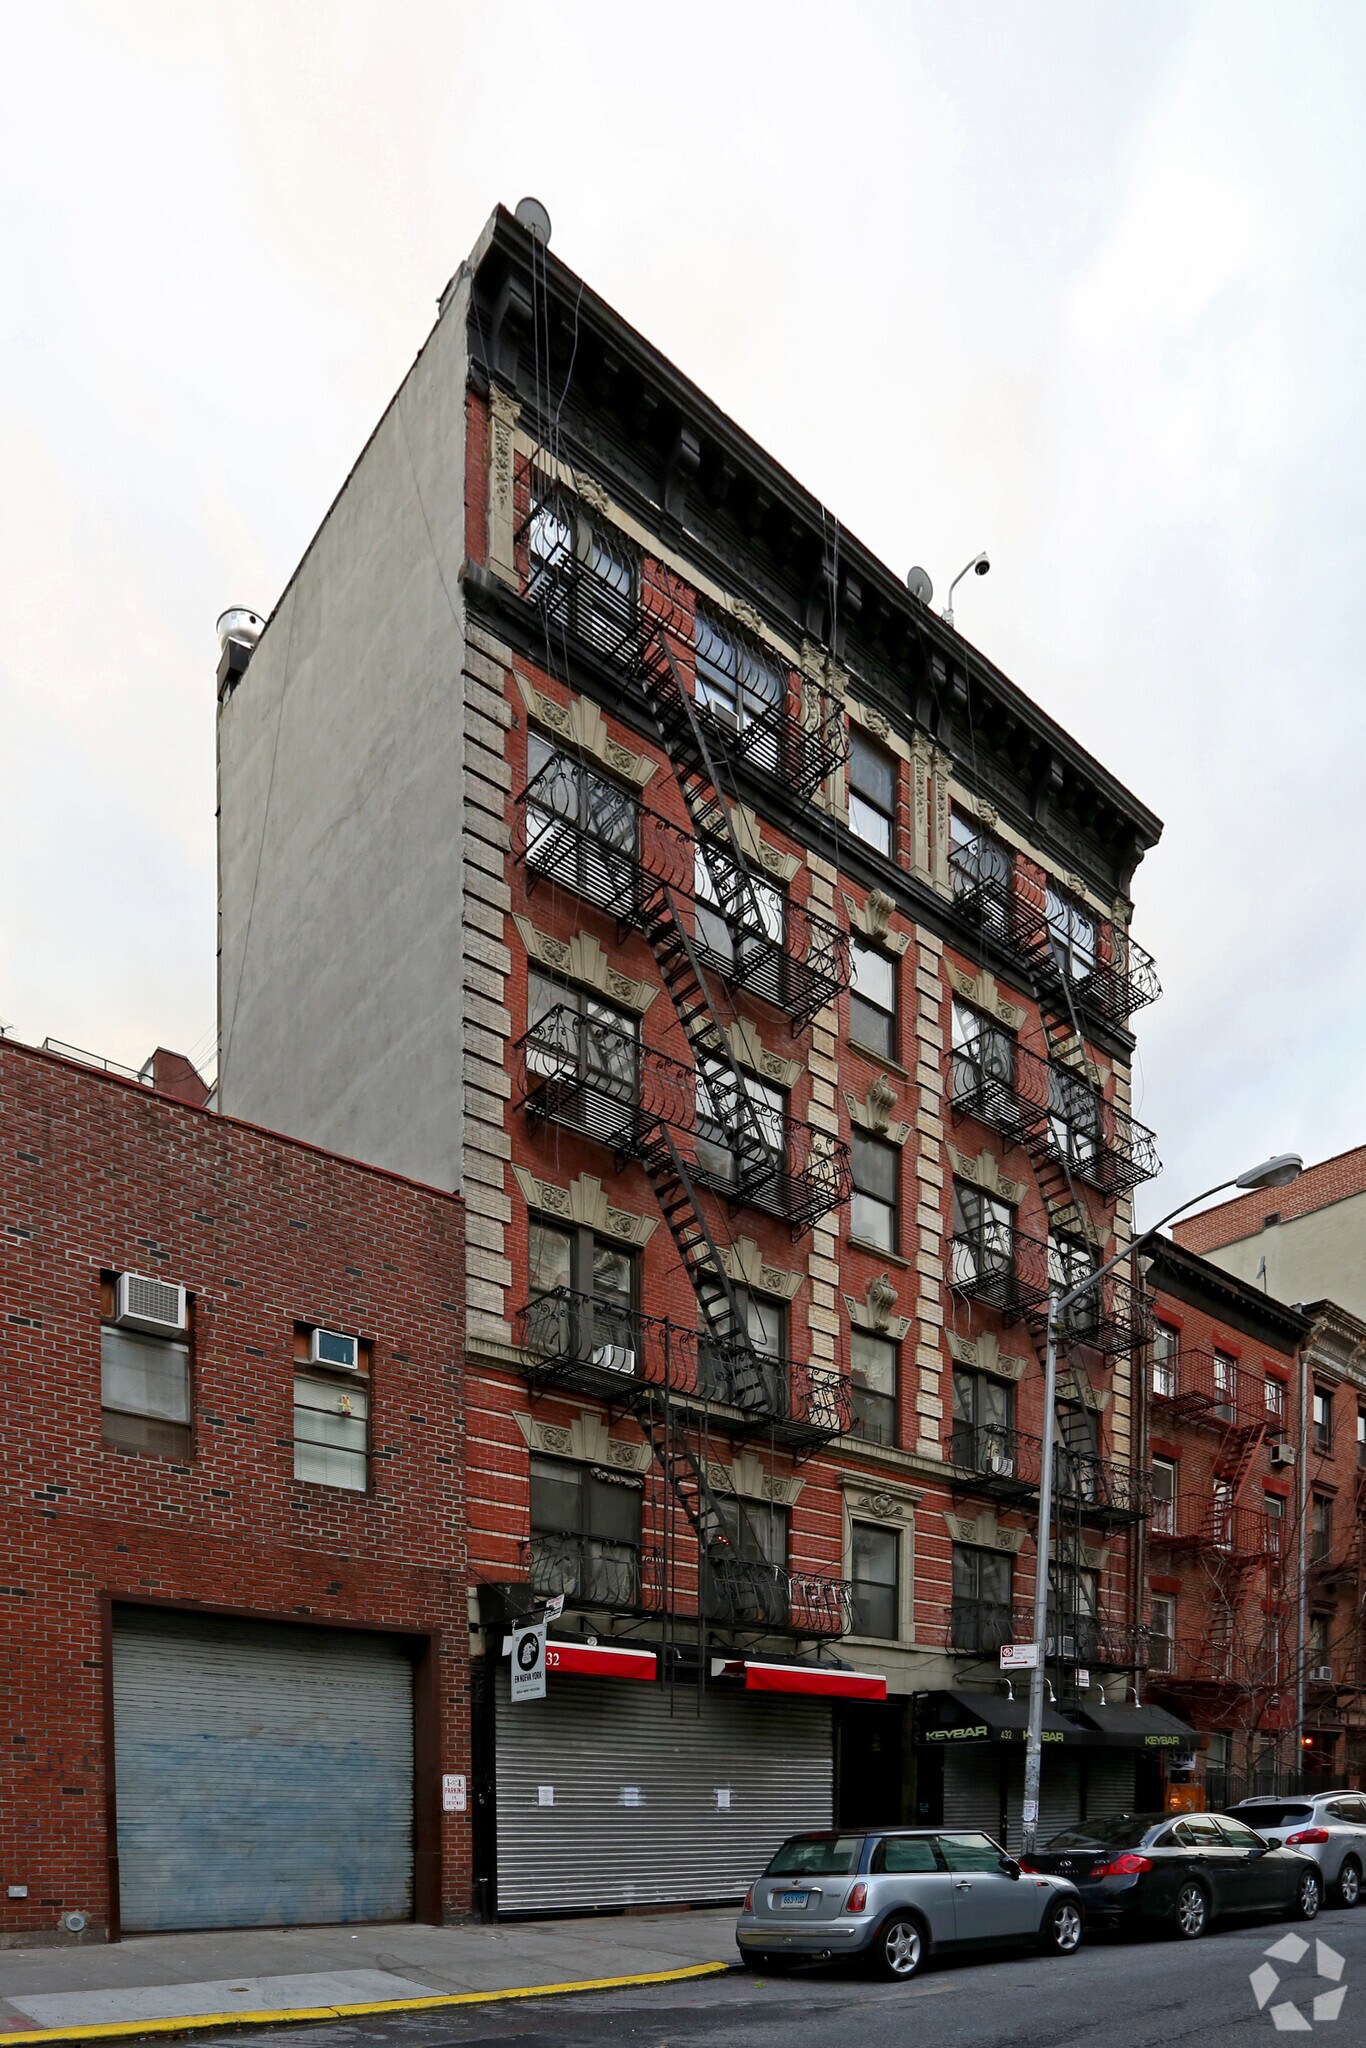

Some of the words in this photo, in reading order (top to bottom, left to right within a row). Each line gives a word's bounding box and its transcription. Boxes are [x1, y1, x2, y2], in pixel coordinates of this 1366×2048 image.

[520, 1673, 532, 1682] NUEVA
[532, 1671, 542, 1680] YORK
[925, 1725, 988, 1741] KEYBAR
[1000, 1730, 1013, 1740] 432
[1022, 1730, 1064, 1742] KBAR
[1144, 1736, 1180, 1745] KEYBAR
[445, 1787, 465, 1795] PARKING
